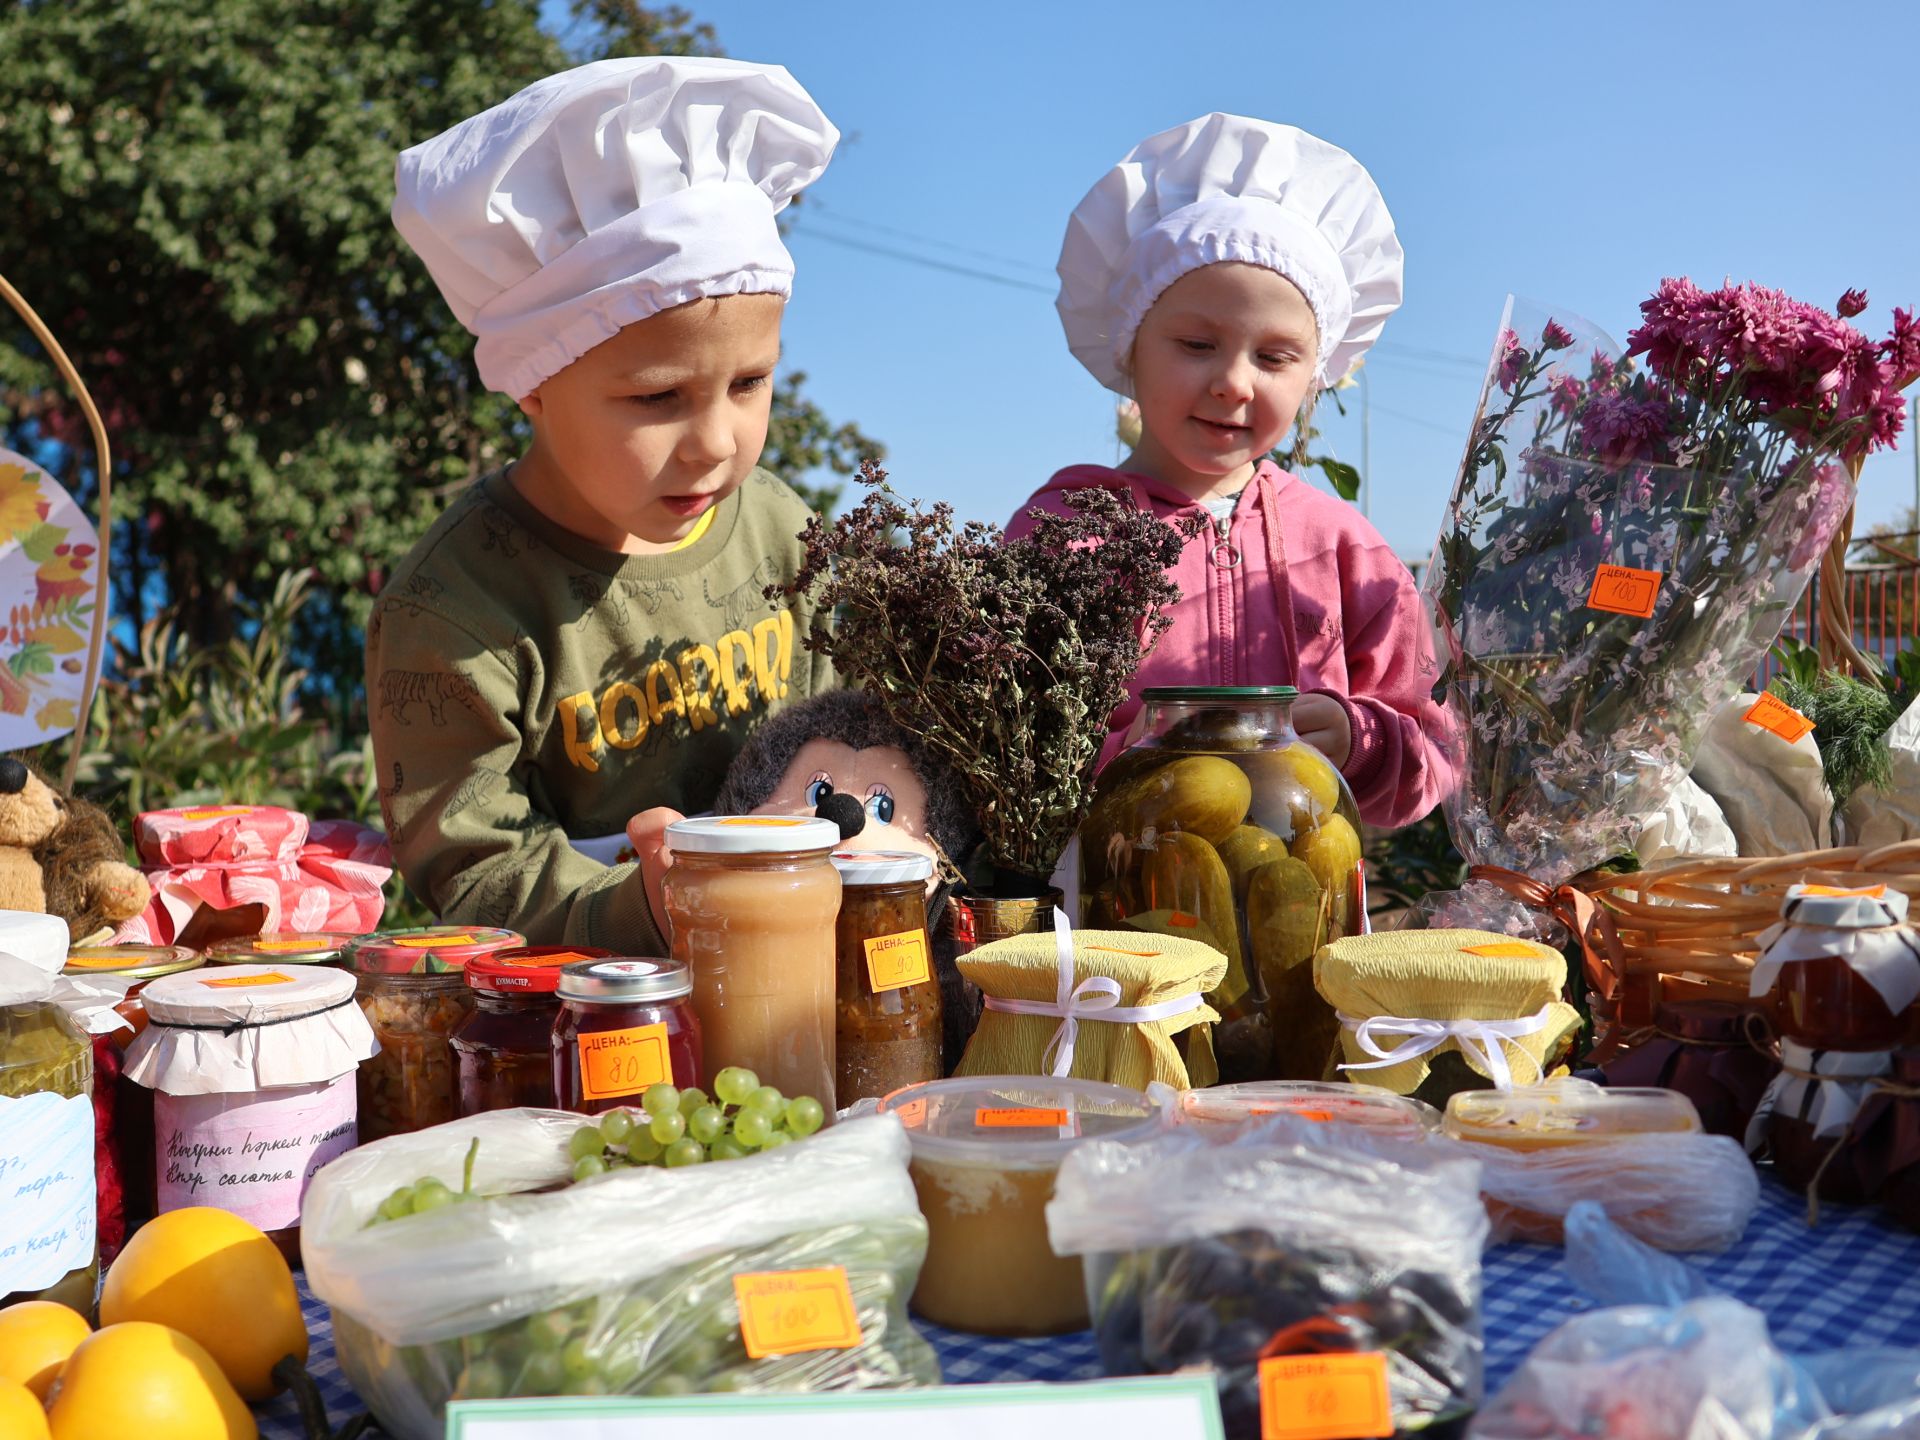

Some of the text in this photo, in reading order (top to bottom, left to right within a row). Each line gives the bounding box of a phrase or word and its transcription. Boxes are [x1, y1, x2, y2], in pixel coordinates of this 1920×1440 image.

[1607, 568, 1635, 580] ЦЕНА:
[1612, 580, 1637, 602] 100
[557, 609, 794, 773] ROARRR!
[876, 937, 906, 952] ЦЕНА:
[895, 955, 914, 976] 90
[495, 977, 529, 987] КУХМАСТЕР
[591, 1036, 631, 1052] ЦЕНА:
[609, 1055, 639, 1084] 80
